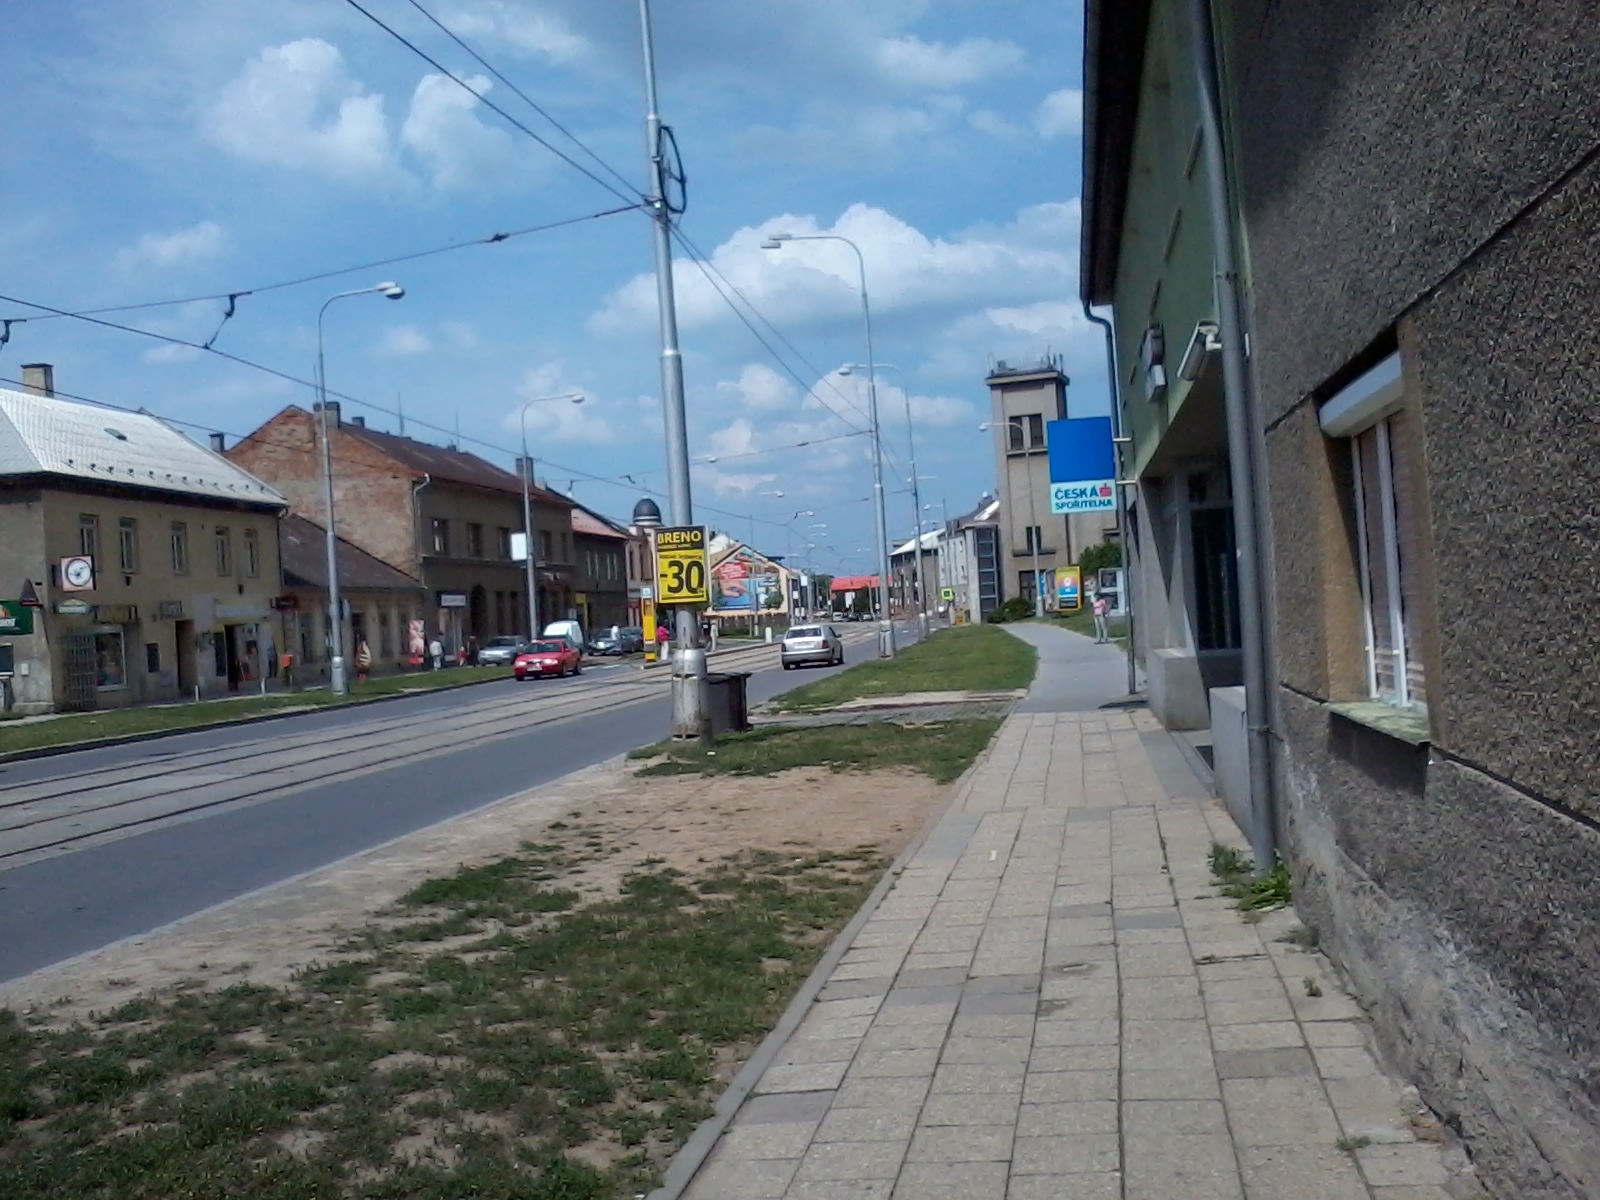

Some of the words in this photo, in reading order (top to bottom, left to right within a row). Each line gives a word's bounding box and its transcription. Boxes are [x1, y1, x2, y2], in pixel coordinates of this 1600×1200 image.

[1055, 485, 1099, 500] ČESKÁ
[1055, 499, 1112, 510] SPOŘITELNA
[658, 530, 702, 544] BRENO
